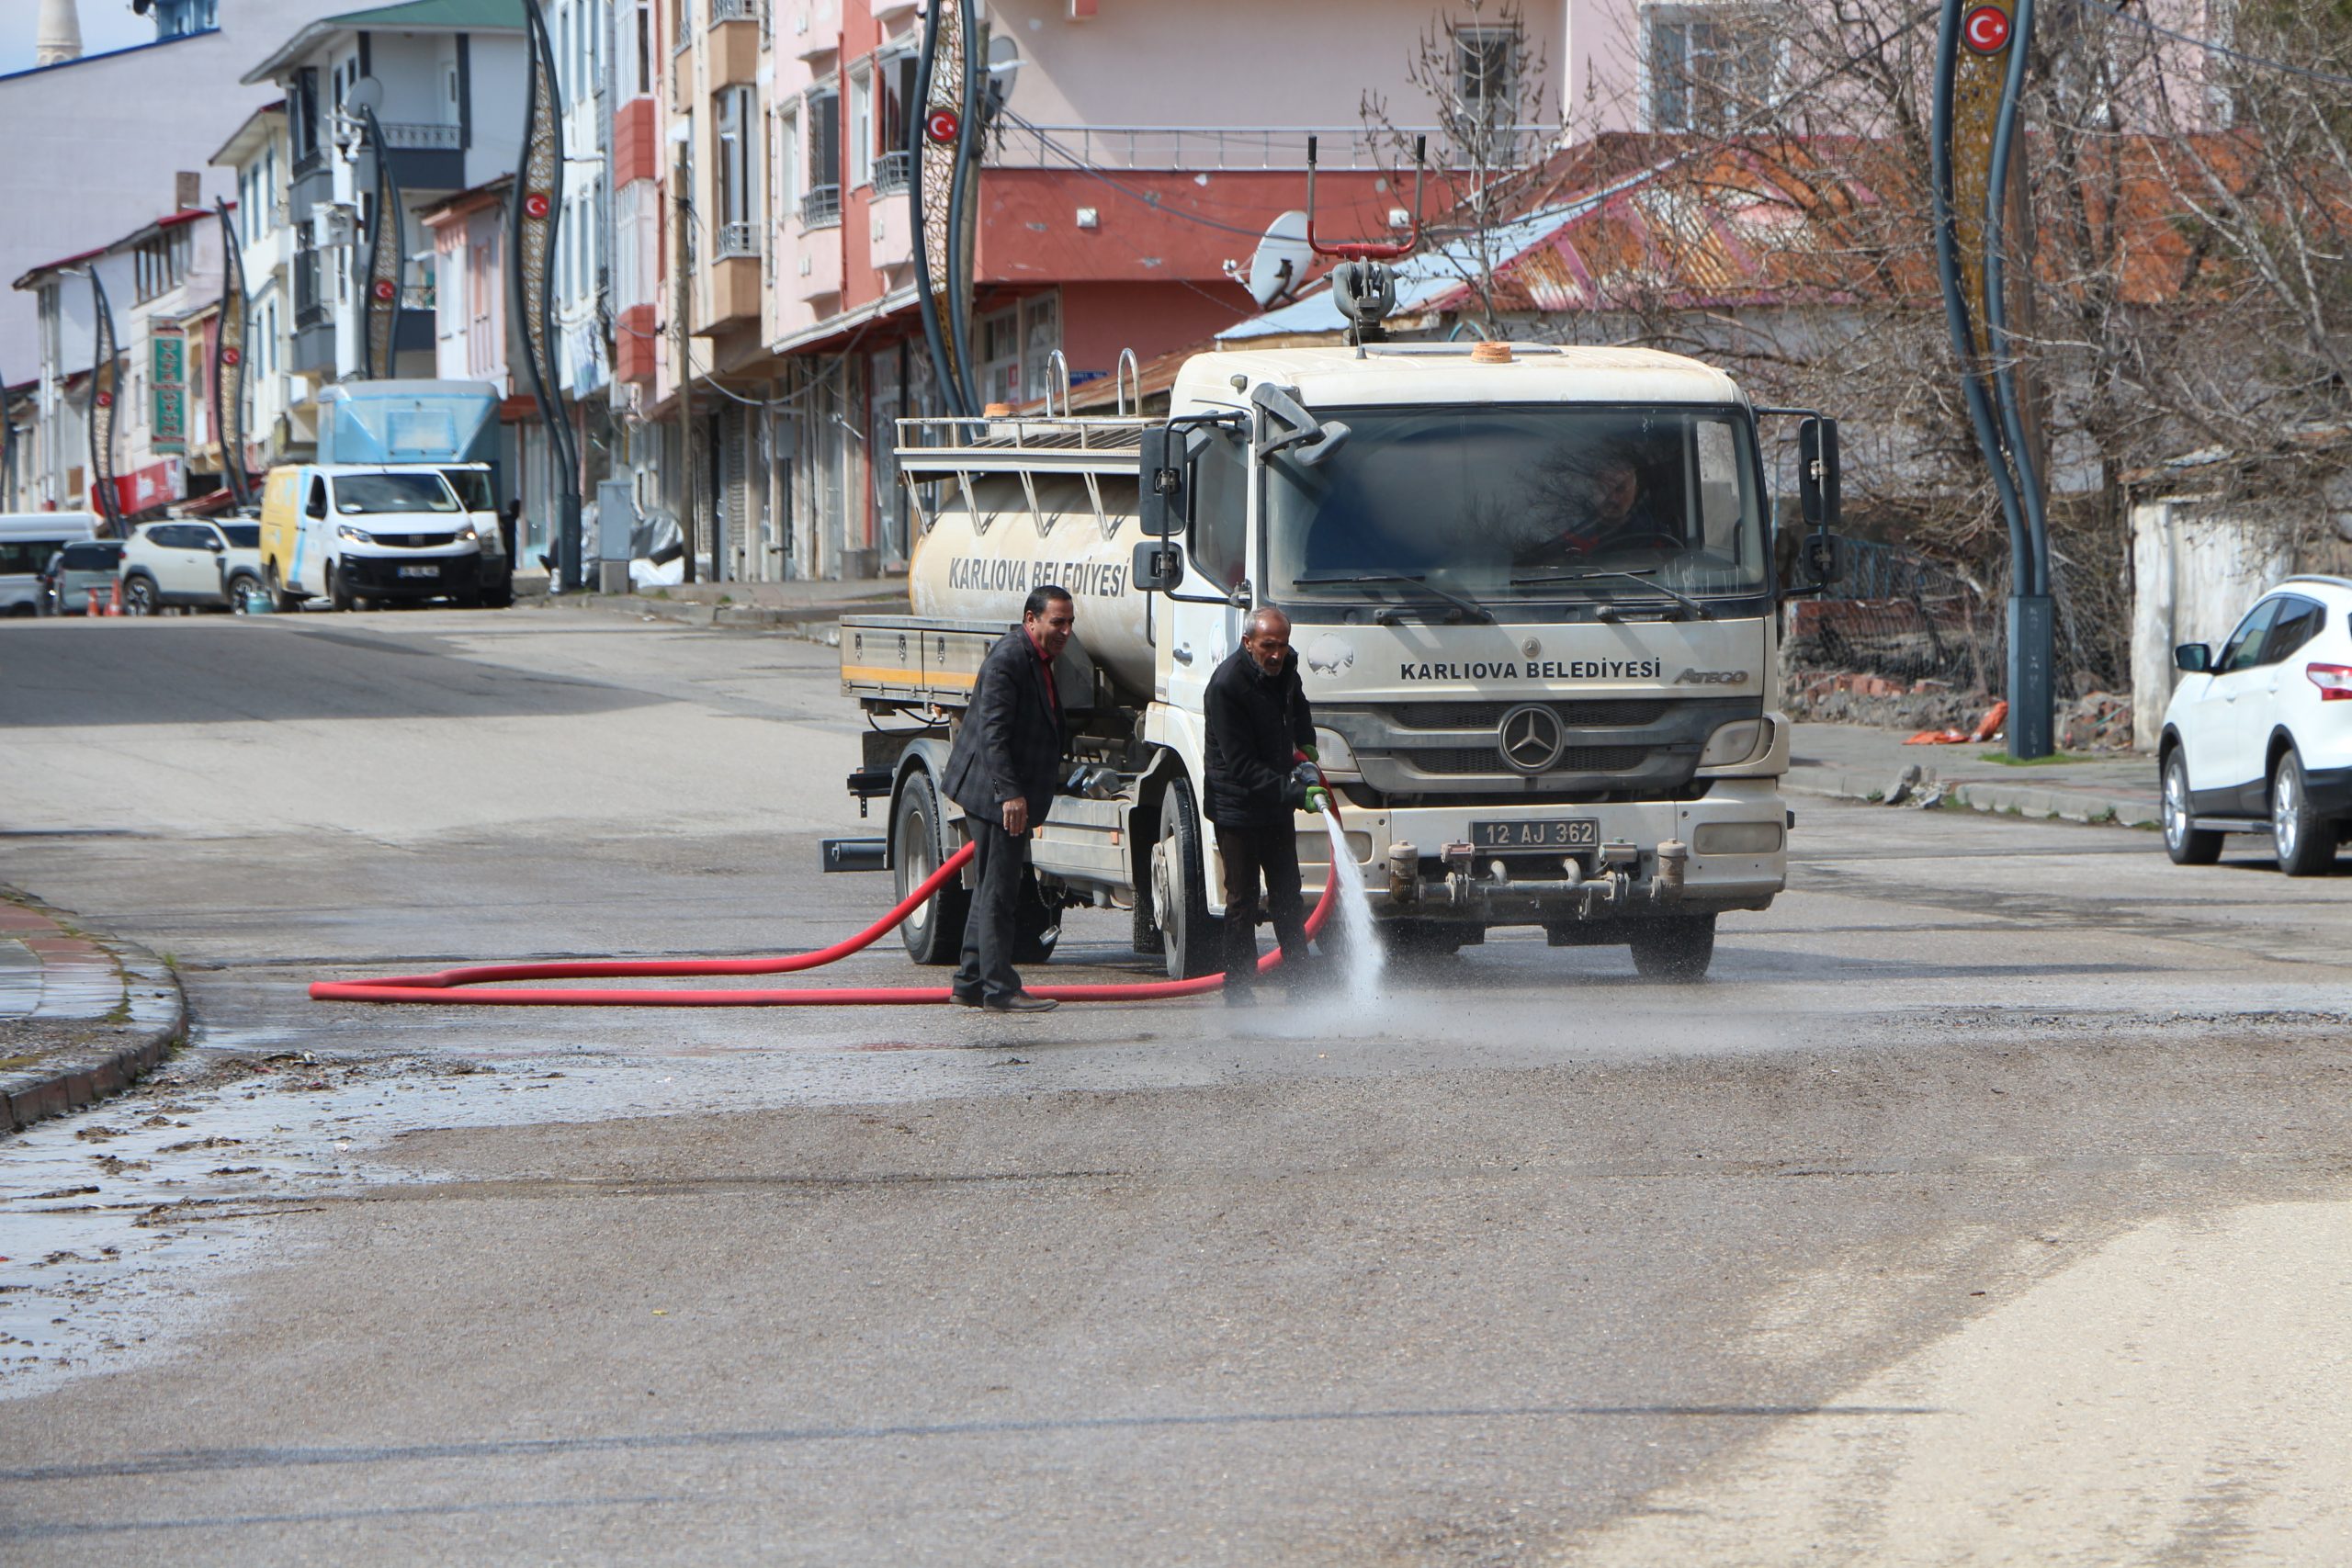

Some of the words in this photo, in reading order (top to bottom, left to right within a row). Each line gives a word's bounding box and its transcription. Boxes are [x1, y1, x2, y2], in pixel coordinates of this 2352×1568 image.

[949, 558, 1026, 592] KARLIOVA
[1032, 556, 1130, 597] BELEDİYESİ
[1400, 662, 1519, 680] KARLIOVA
[1526, 657, 1661, 679] BELEDİYESİ
[1487, 824, 1510, 844] 12
[1521, 823, 1544, 843] AJ
[1555, 822, 1593, 843] 362
